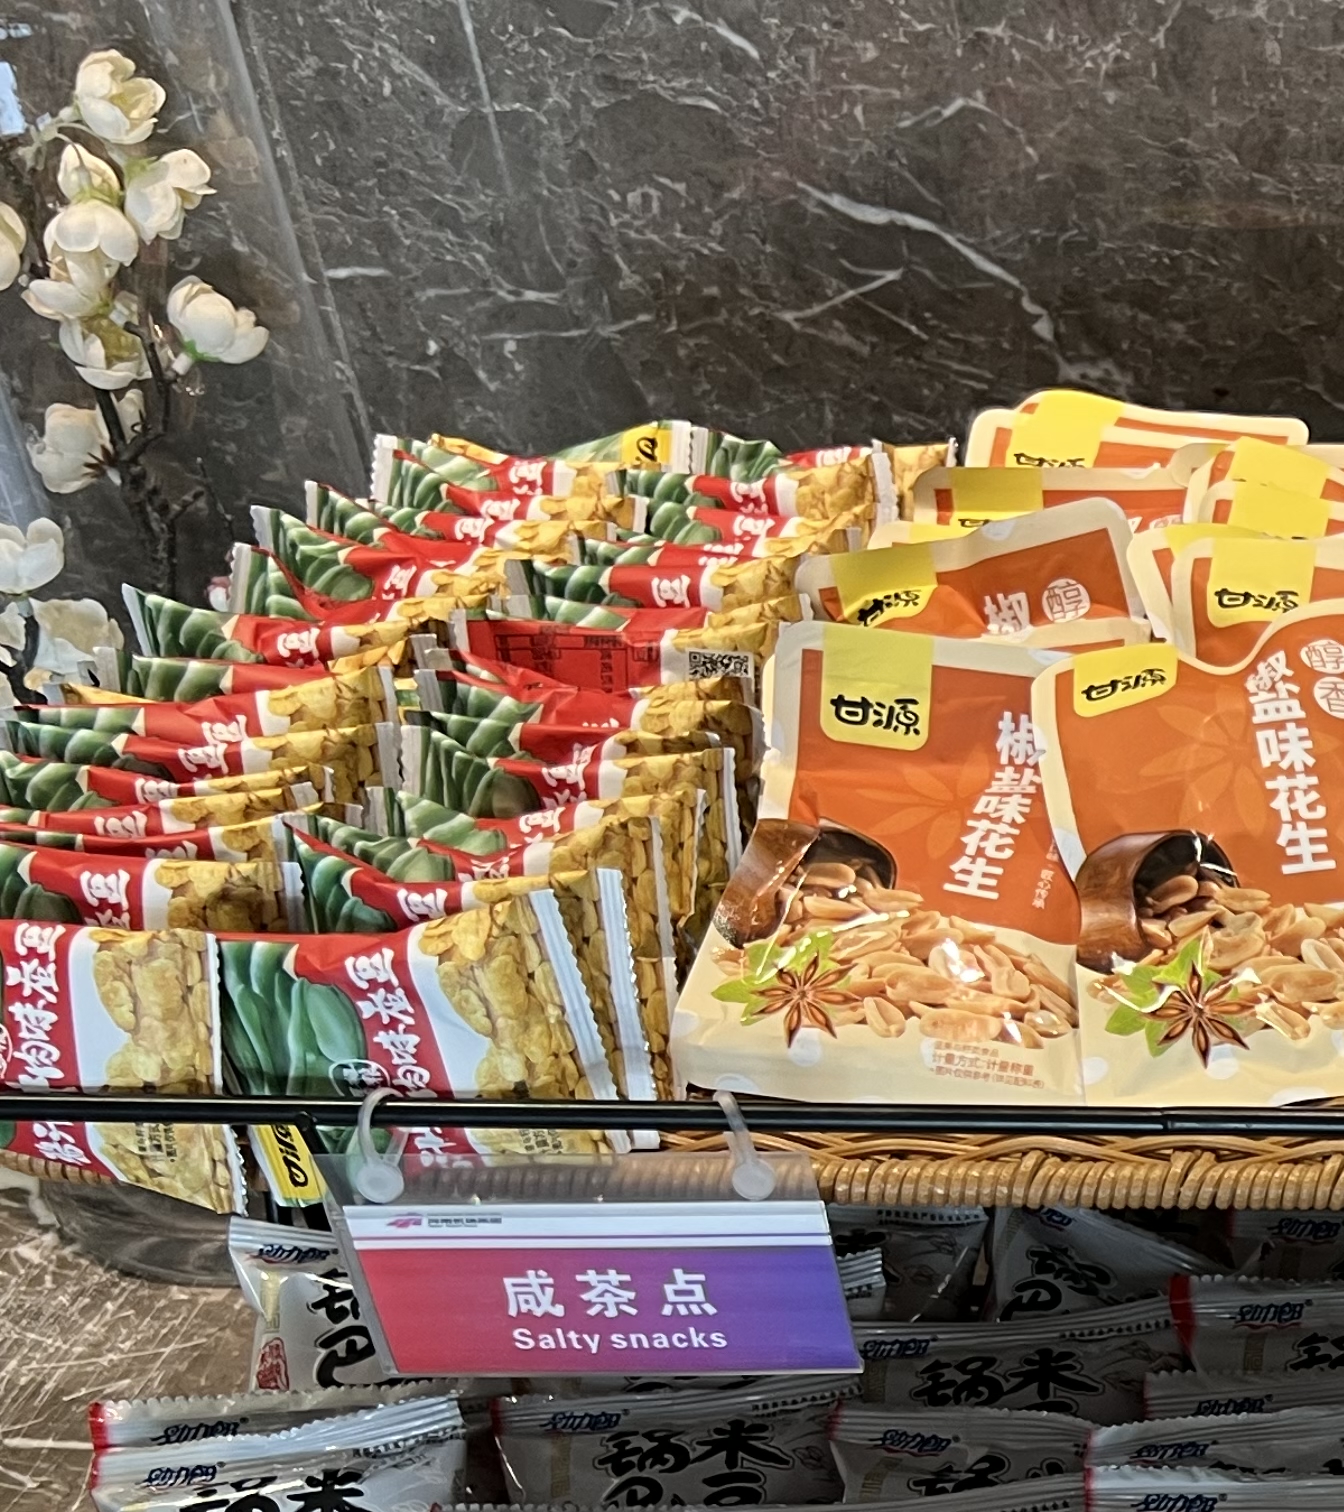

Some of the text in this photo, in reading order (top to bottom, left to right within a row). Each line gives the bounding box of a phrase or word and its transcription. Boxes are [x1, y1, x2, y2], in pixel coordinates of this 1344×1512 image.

[1081, 666, 1168, 704] 甘源
[829, 694, 922, 738] 甘源
[1243, 649, 1338, 876] 椒盐味花生
[942, 710, 1048, 900] 椒盐味花生
[501, 1267, 720, 1320] 咸茶点
[511, 1326, 728, 1354] Salty snacks
